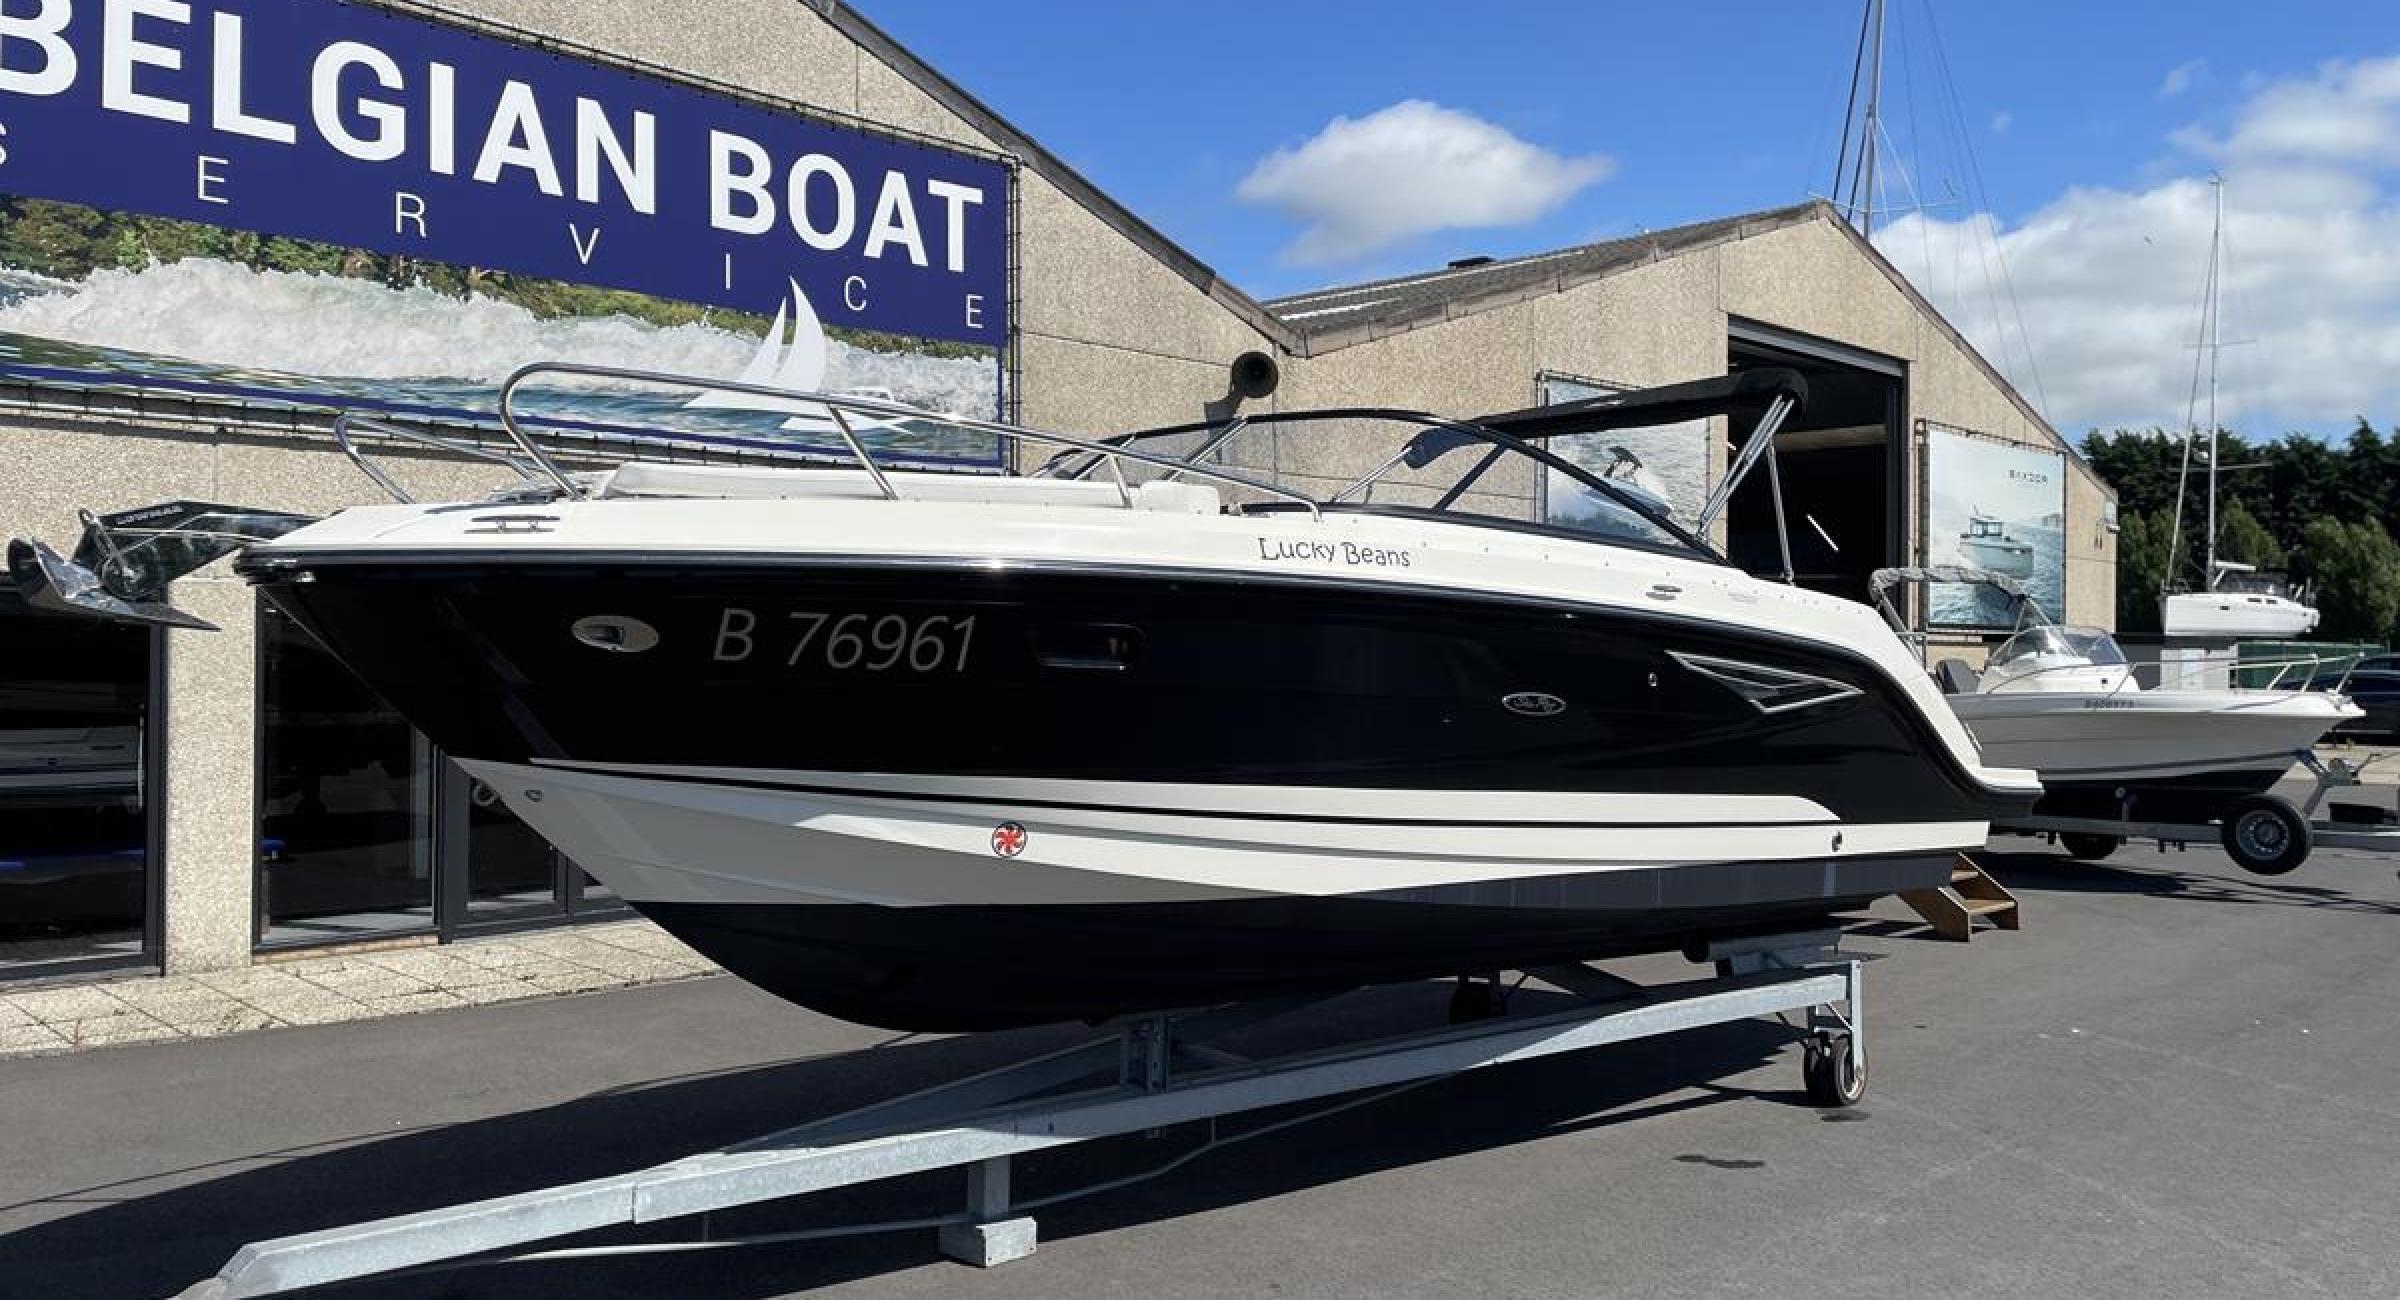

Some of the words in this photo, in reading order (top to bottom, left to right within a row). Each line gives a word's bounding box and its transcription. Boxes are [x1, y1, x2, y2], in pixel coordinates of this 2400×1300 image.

[0, 0, 656, 215] BELGIAN
[710, 129, 983, 273] BOAT
[0, 121, 984, 330] ERVICE
[1340, 541, 1411, 567] Beans
[713, 607, 756, 661] B
[786, 611, 976, 672] 76961
